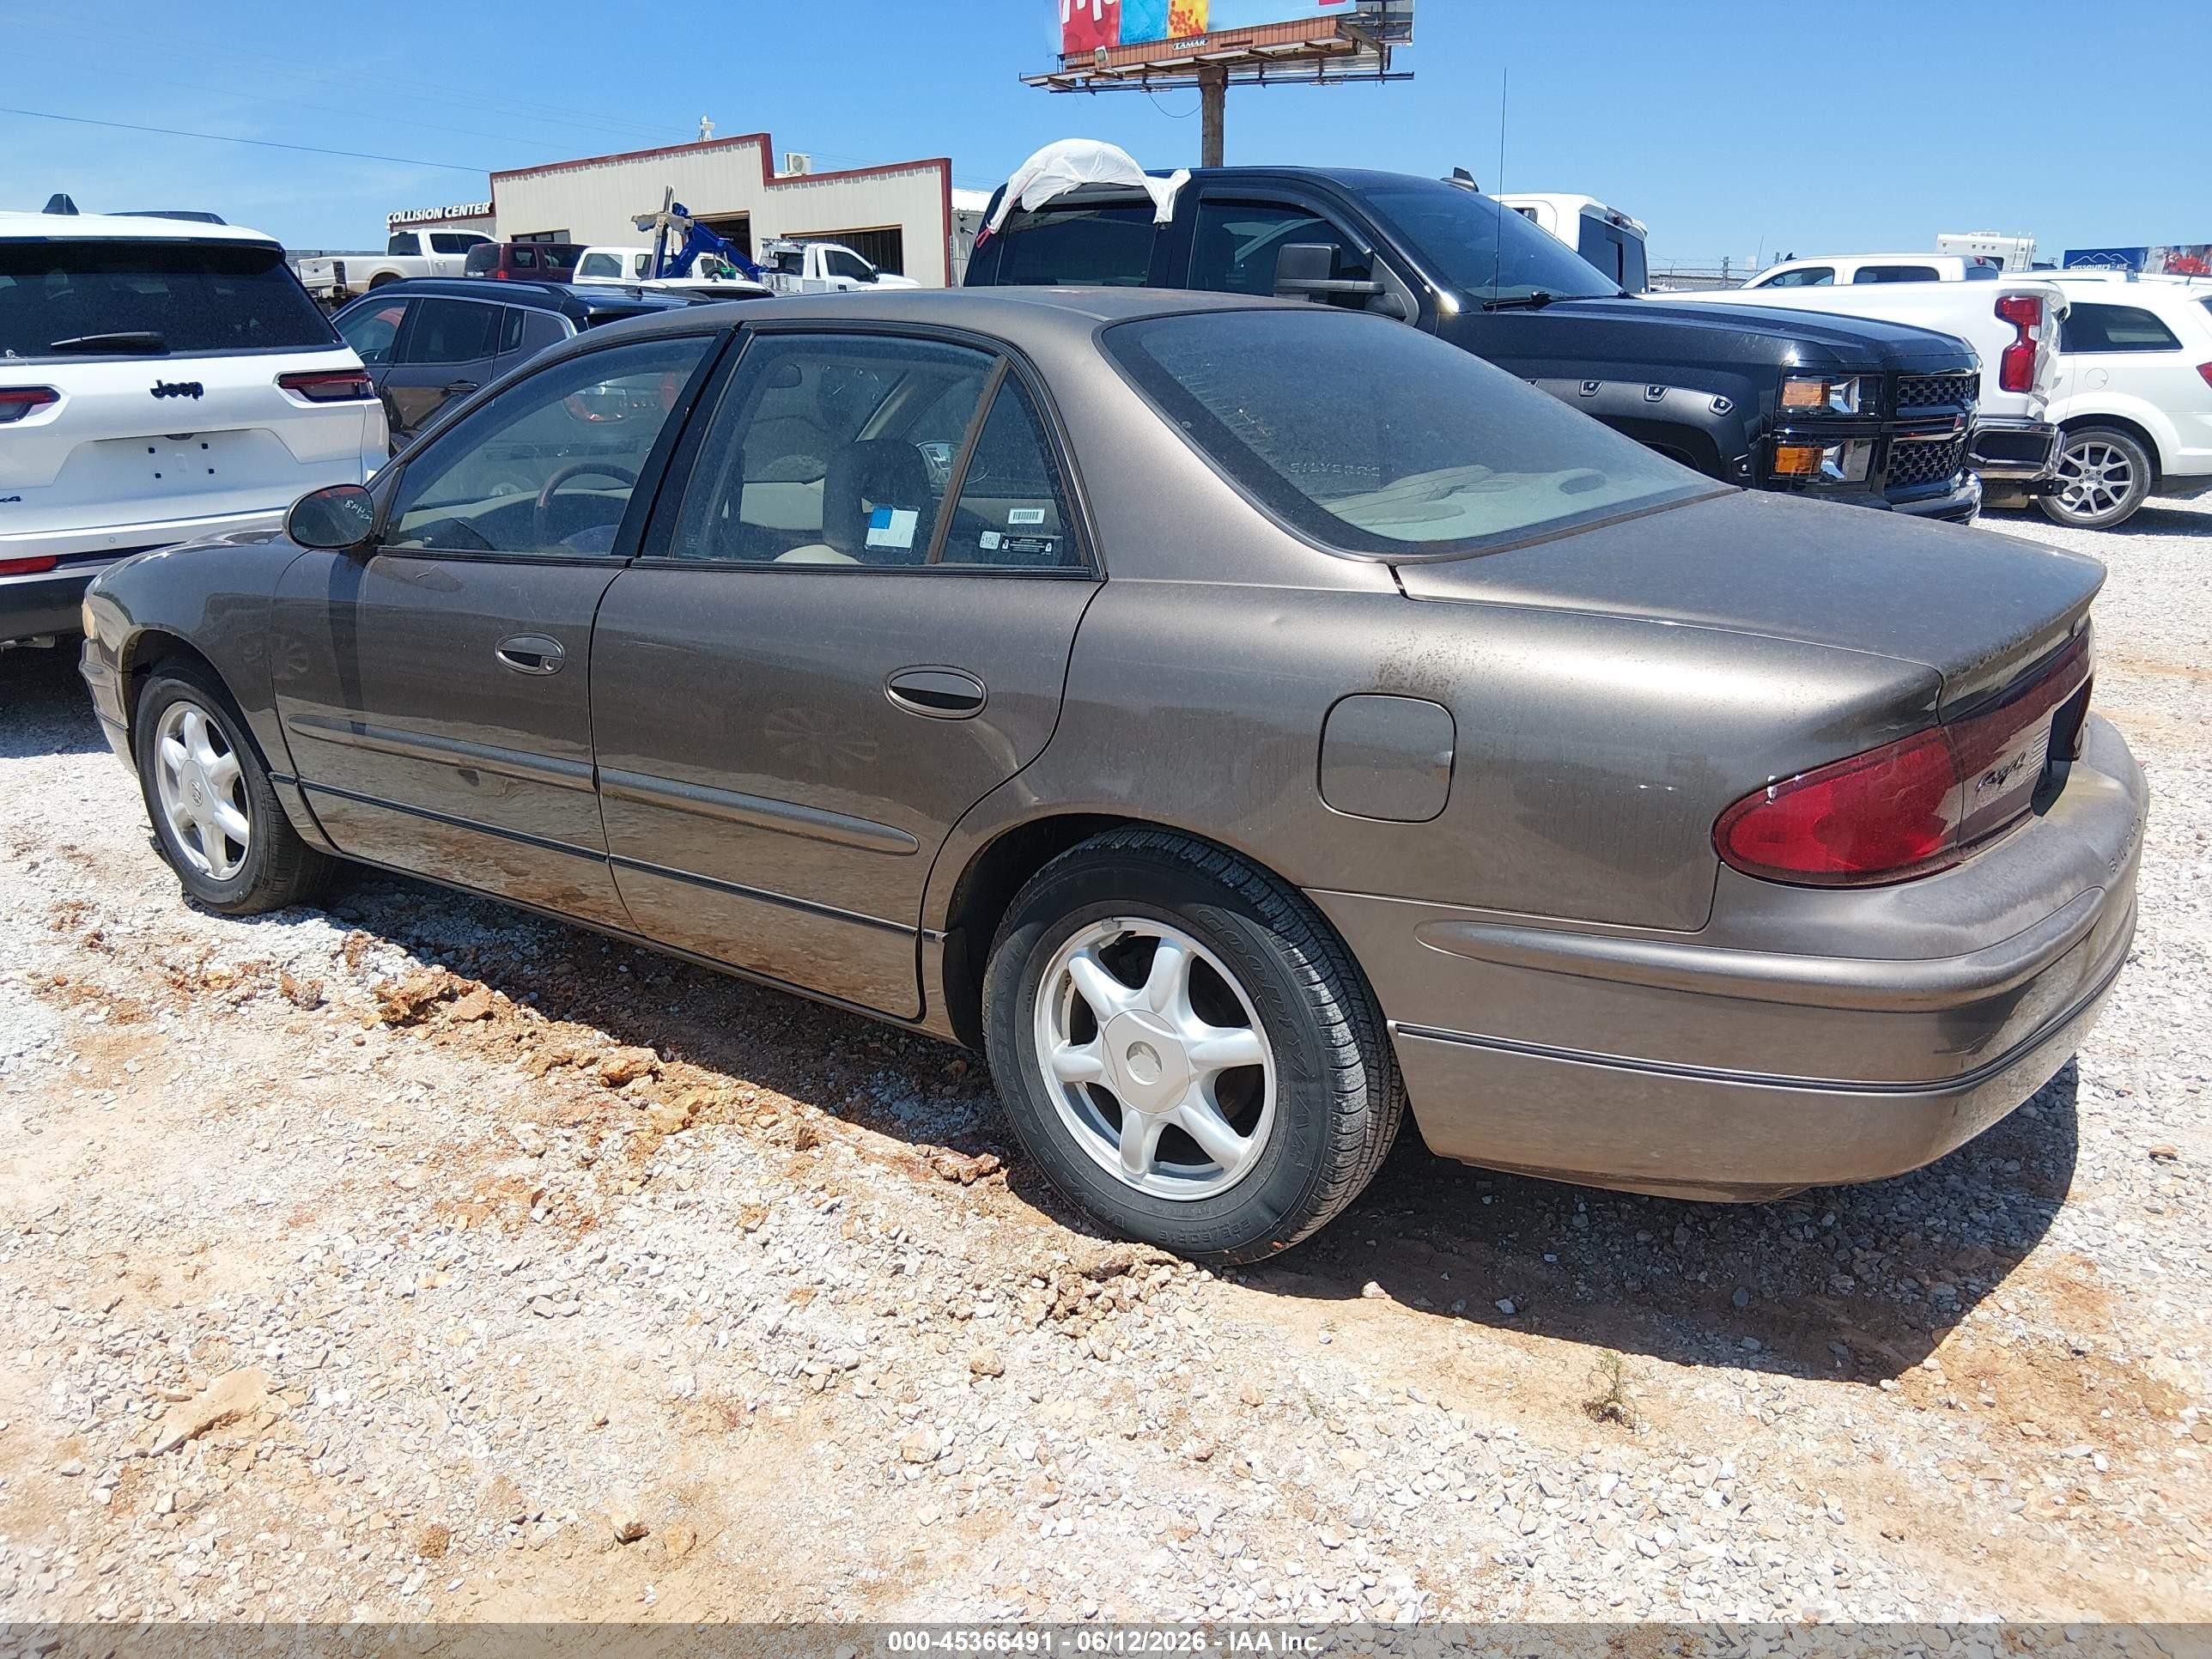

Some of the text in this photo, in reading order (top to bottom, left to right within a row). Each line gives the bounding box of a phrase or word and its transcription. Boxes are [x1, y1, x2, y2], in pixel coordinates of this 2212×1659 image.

[386, 201, 491, 224] COLLISION CENTER
[149, 379, 204, 400] Jeep
